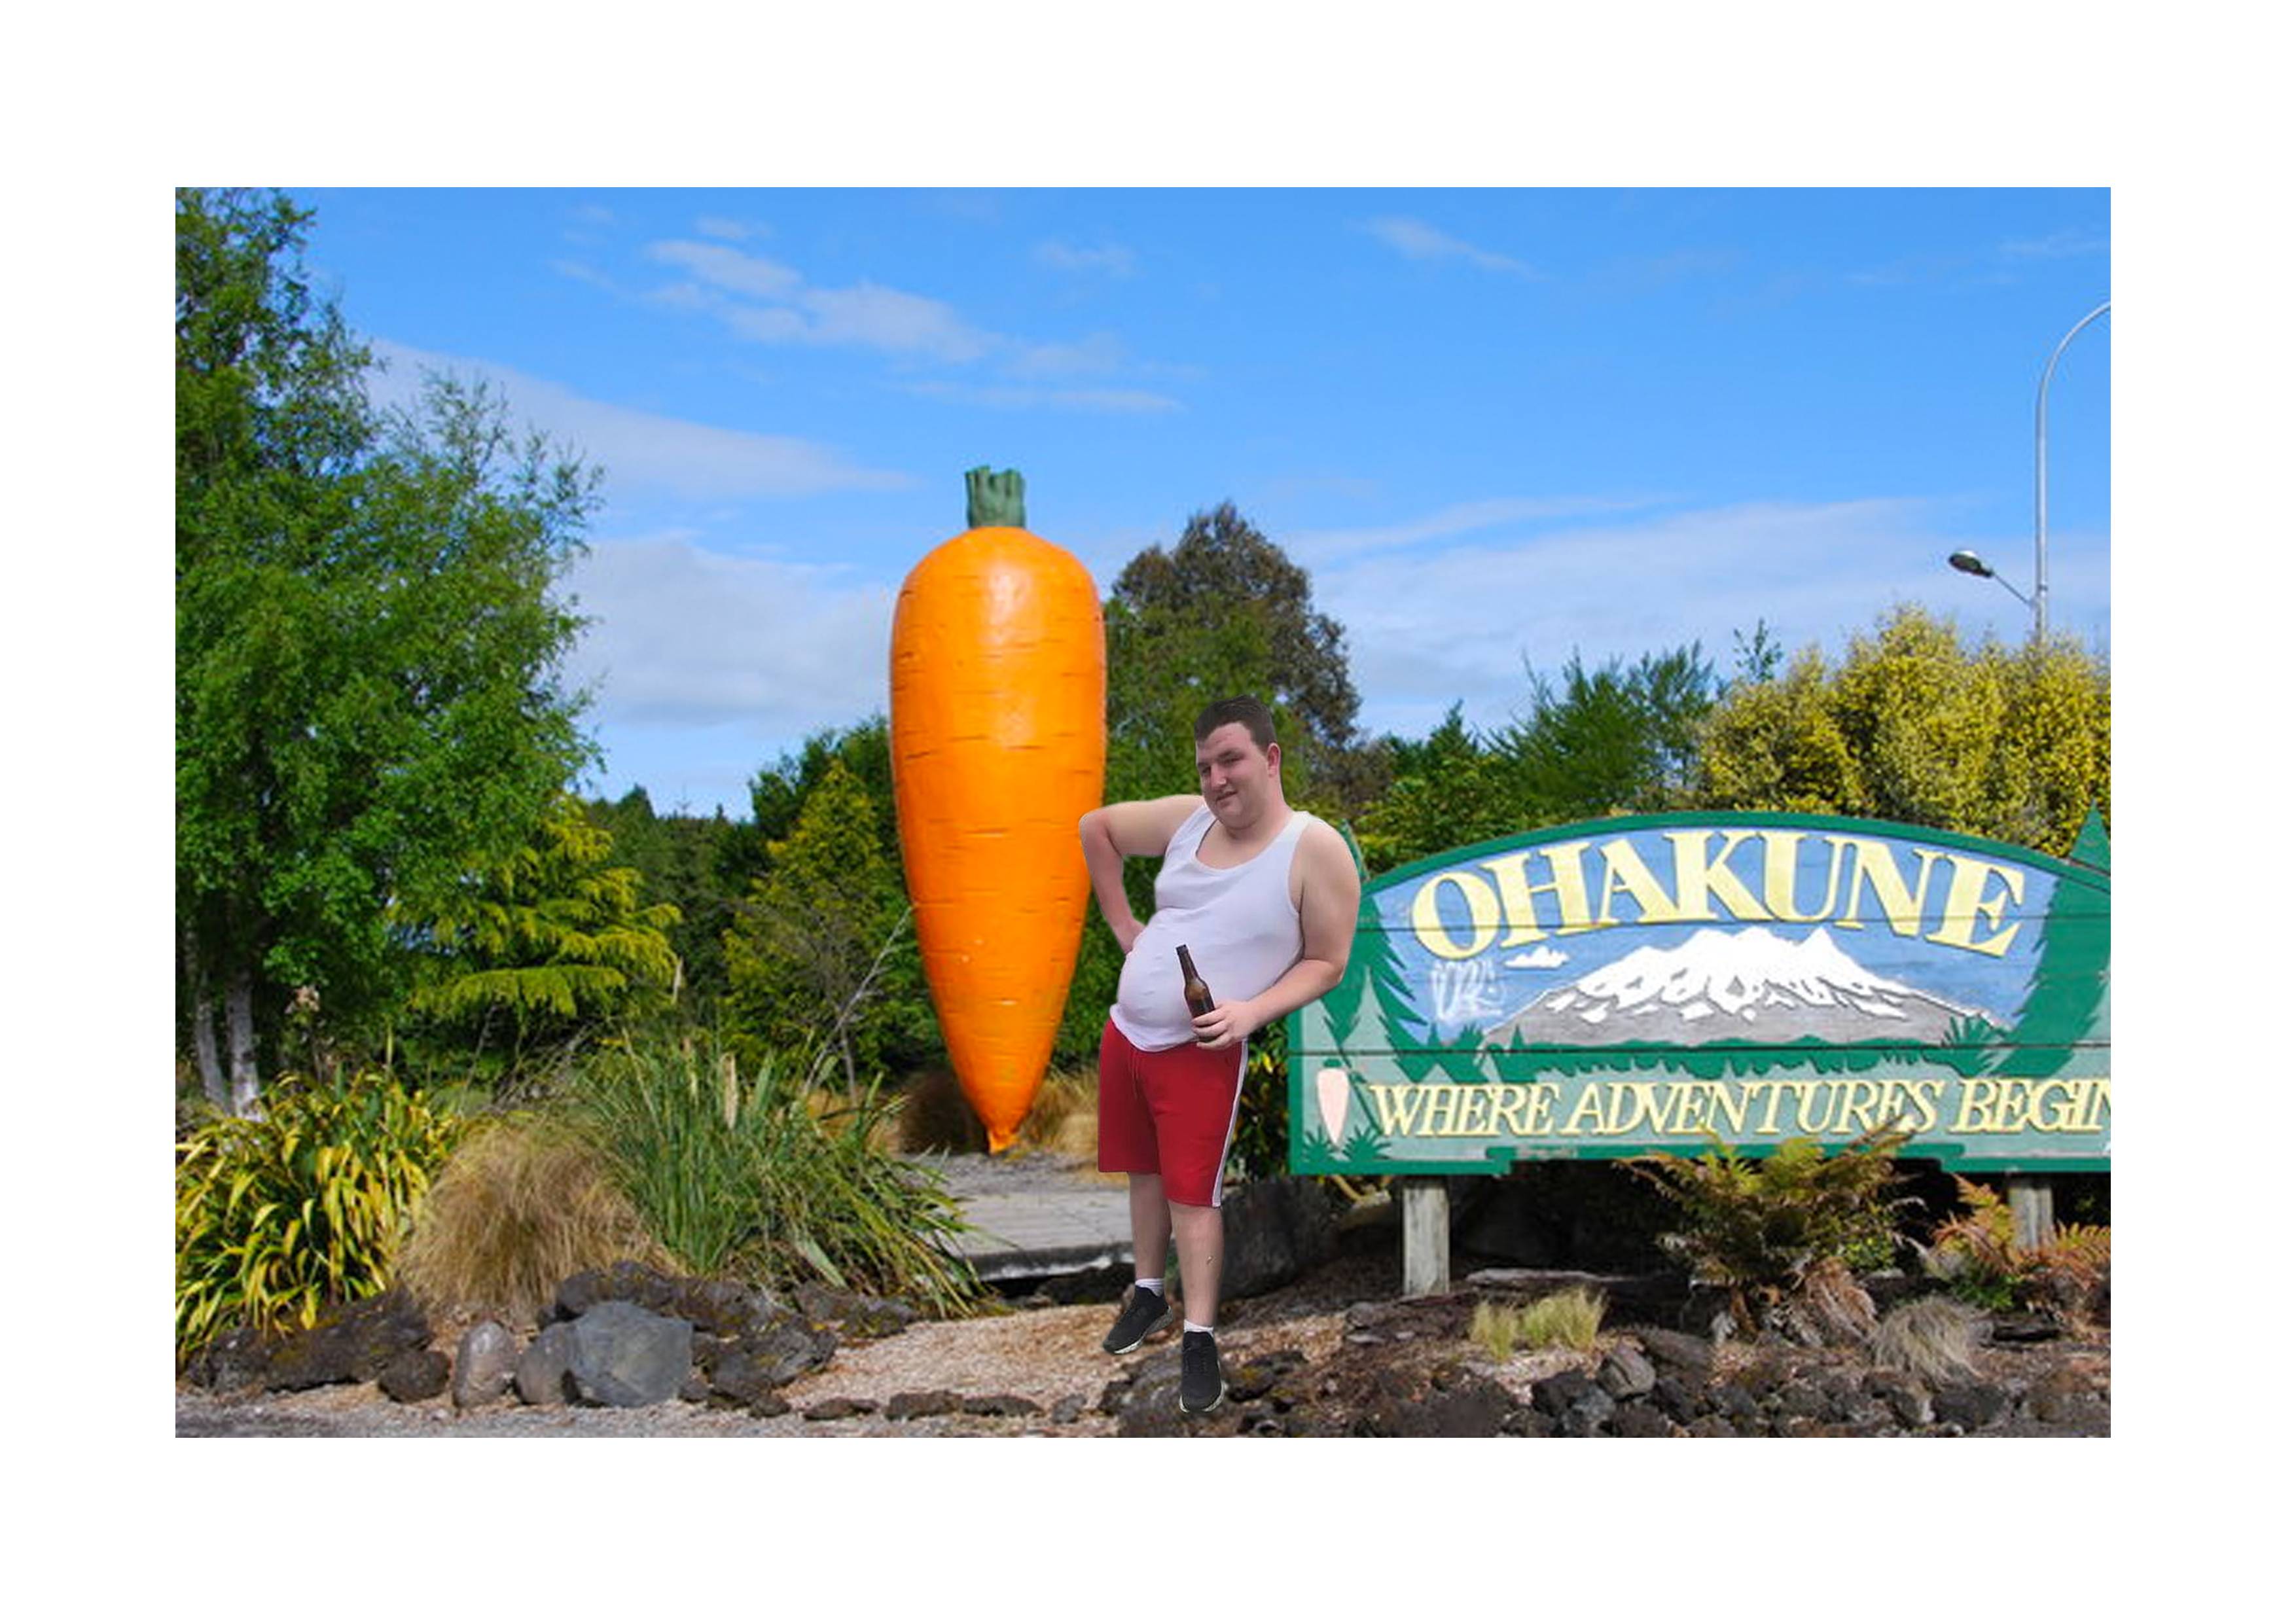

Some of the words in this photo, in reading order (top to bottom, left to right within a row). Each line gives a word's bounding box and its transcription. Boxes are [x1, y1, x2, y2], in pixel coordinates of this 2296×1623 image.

[1410, 830, 2025, 960] OHAKUNE
[1370, 1080, 1560, 1139] WHERE
[1561, 1079, 1945, 1135] ADVENTURES
